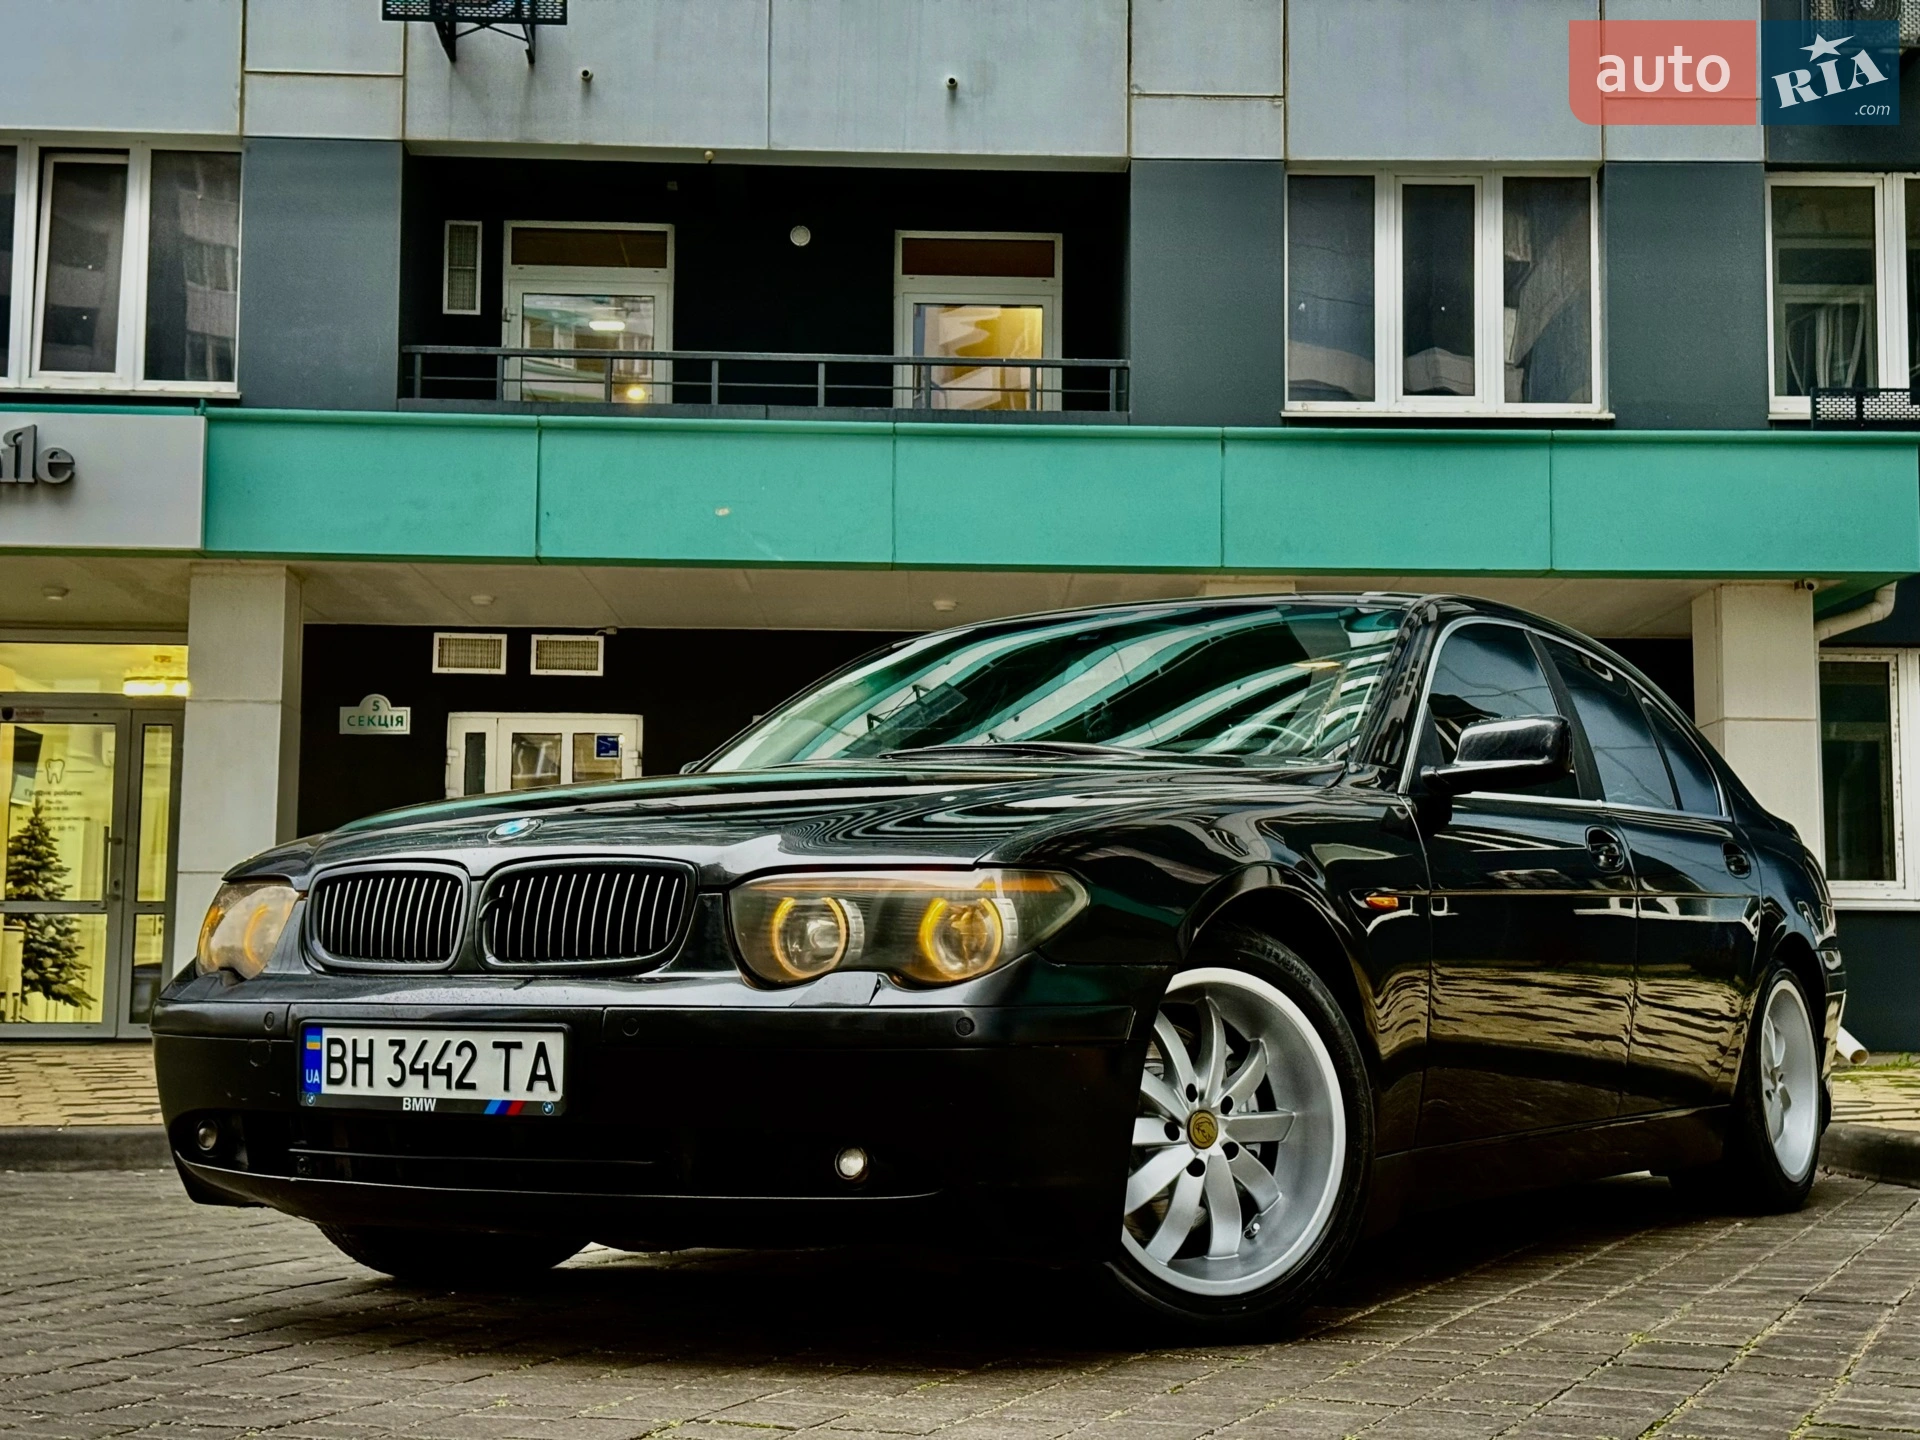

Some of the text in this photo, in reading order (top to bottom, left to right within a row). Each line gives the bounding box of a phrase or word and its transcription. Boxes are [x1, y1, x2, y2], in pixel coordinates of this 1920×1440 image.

[0, 424, 75, 484] ile
[371, 700, 380, 712] 5
[346, 714, 404, 728] СЕКЦІЯ
[326, 1037, 556, 1093] BH 3442 TA
[305, 1068, 320, 1084] UA
[402, 1097, 437, 1112] BMW
